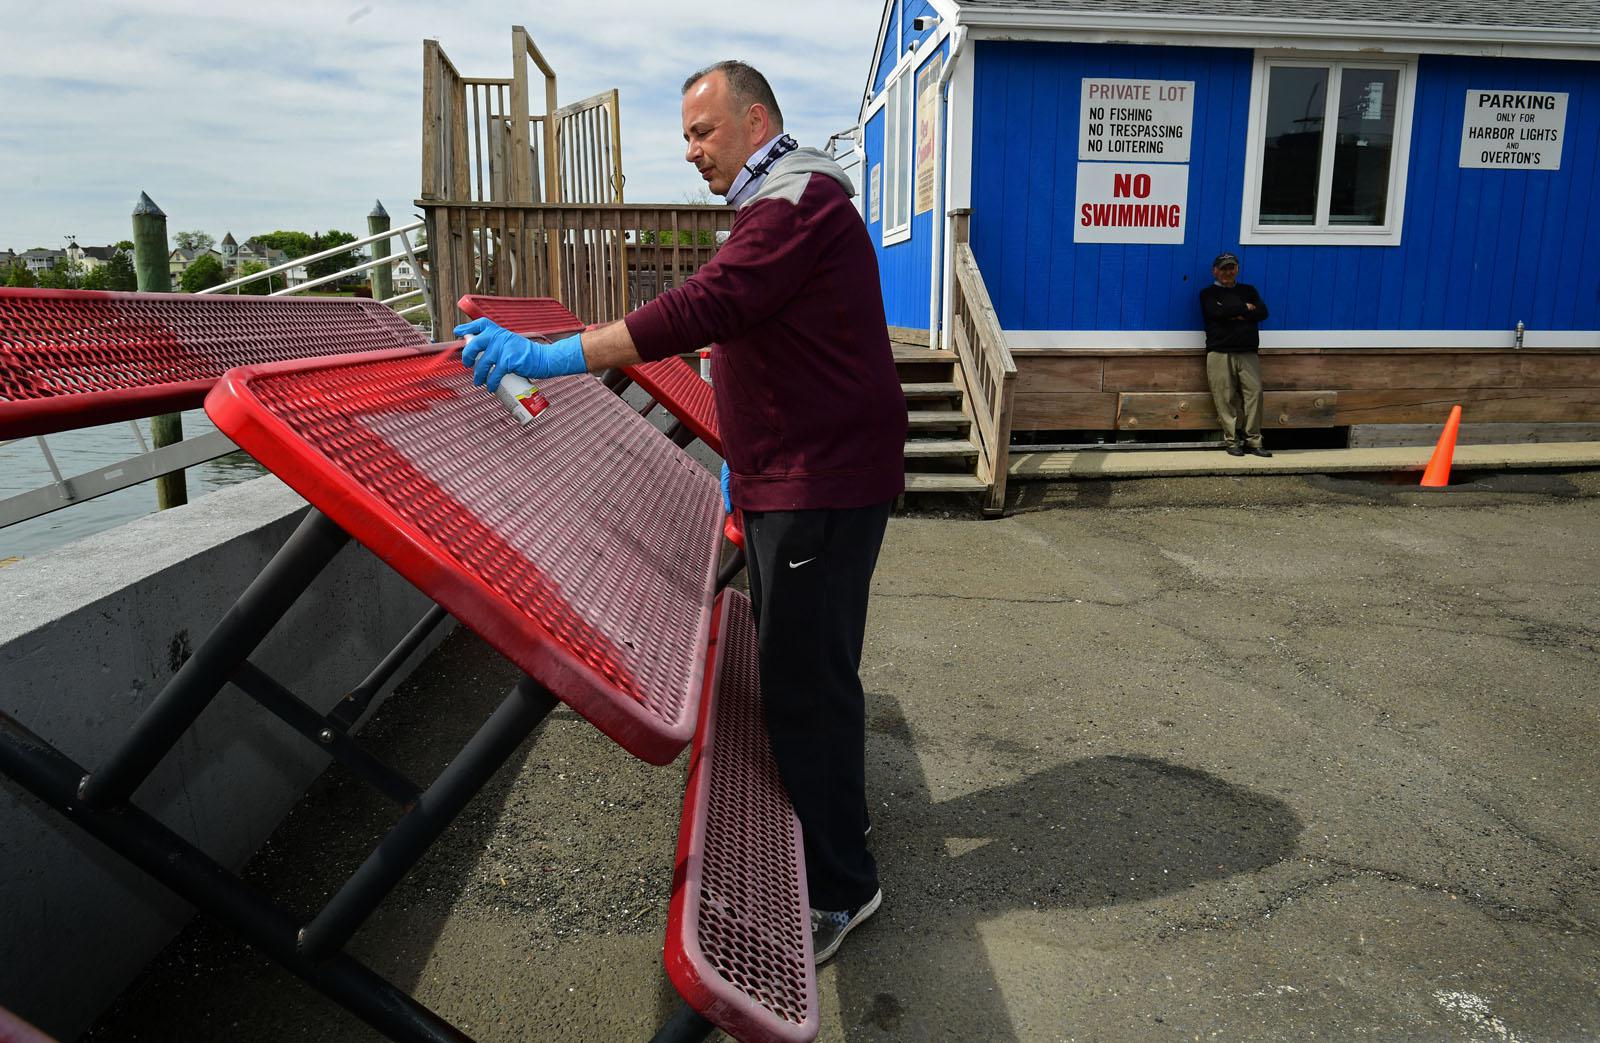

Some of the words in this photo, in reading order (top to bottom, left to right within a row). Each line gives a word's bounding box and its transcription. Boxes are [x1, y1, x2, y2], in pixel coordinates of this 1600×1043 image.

[1089, 84, 1151, 100] PRIVATE
[1159, 87, 1187, 102] LOT
[1479, 93, 1556, 110] PARKING
[1090, 107, 1104, 120] NO
[1110, 108, 1152, 121] FISHING
[1496, 113, 1516, 122] ONLY
[1520, 113, 1535, 123] FOR
[1088, 124, 1104, 136] NO
[1110, 124, 1183, 138] TRESPASSING
[1469, 127, 1515, 140] HARBOR
[1520, 128, 1558, 141] LIGHTS
[1088, 140, 1103, 152] NO
[1108, 140, 1163, 153] LOITERING
[1506, 142, 1519, 150] AND
[1481, 151, 1541, 164] OVERTON'S
[1113, 173, 1152, 199] NO
[1081, 203, 1181, 228] SWIMMING
